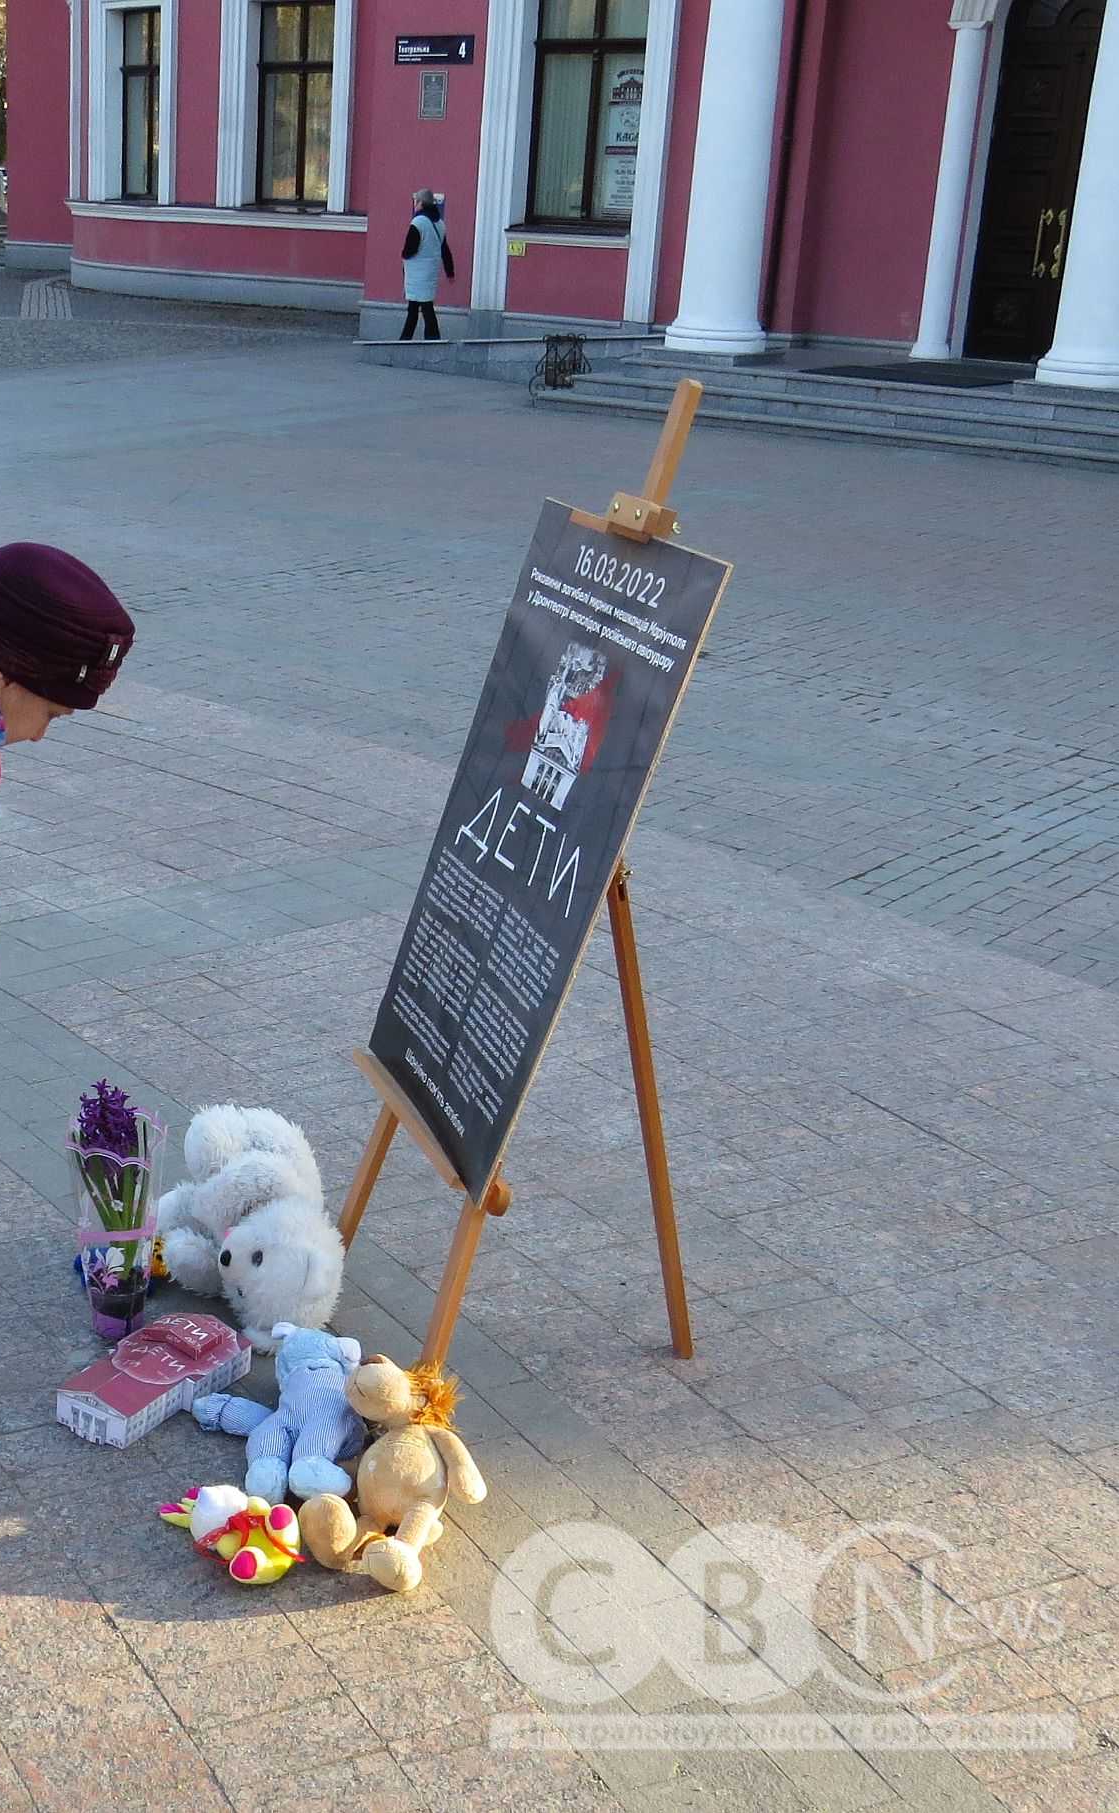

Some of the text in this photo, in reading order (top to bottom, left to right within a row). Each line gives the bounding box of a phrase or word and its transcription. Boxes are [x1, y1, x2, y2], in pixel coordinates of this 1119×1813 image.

[458, 41, 466, 58] 4
[573, 545, 667, 609] 16.03.2022
[647, 621, 688, 651] Маріуполя
[455, 787, 581, 919] ДЕТИ
[131, 1346, 186, 1373] ДЕТИ
